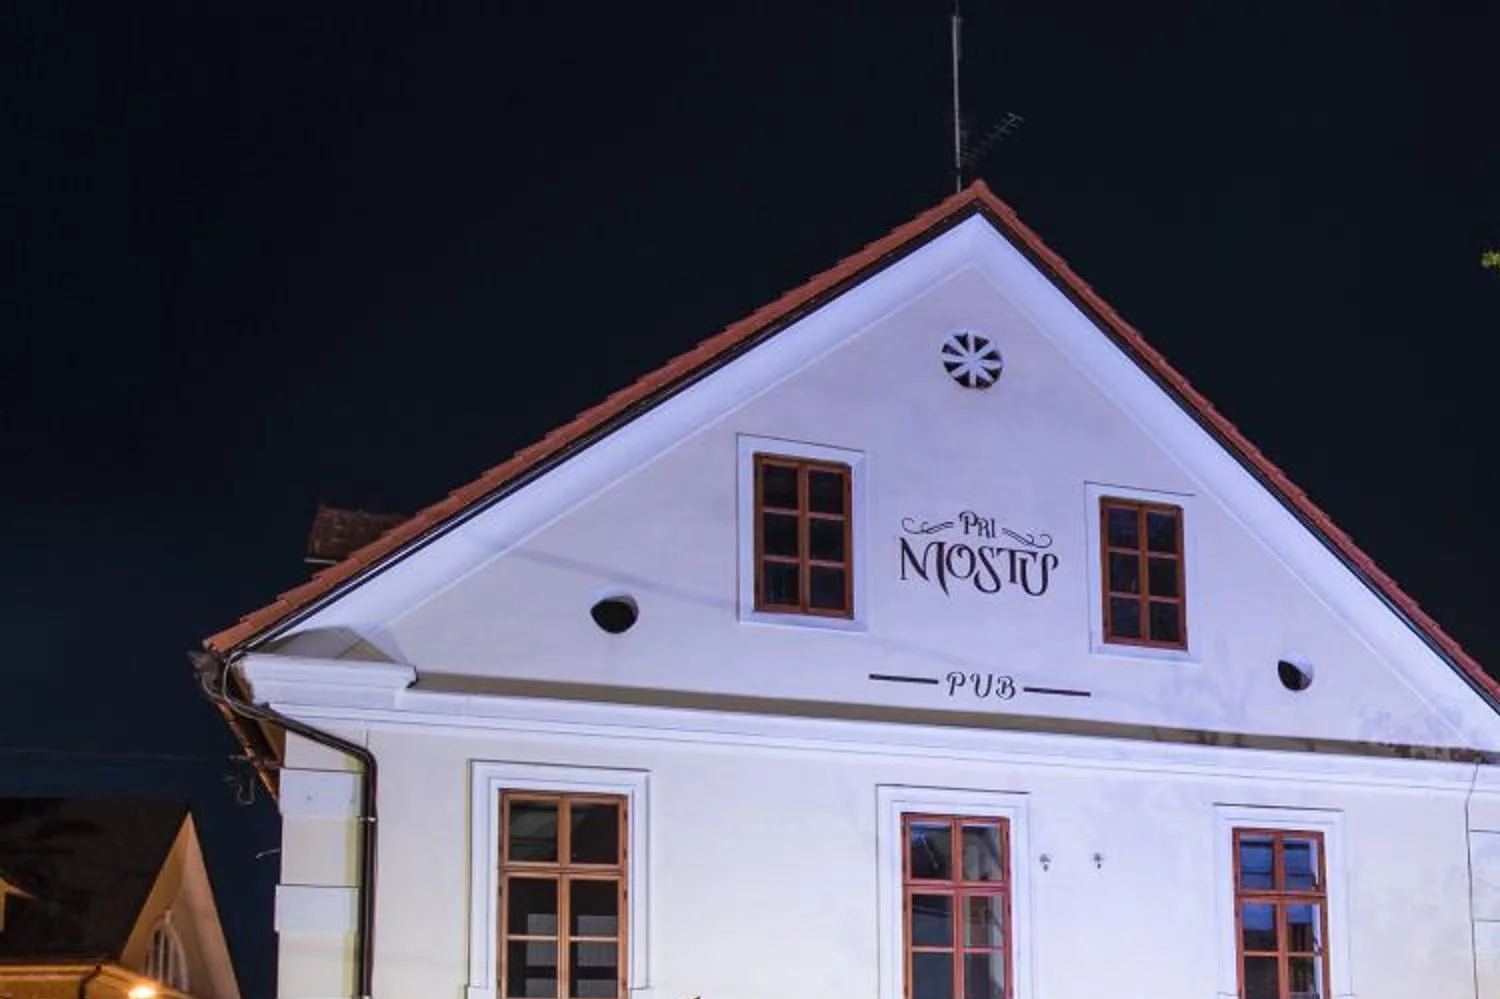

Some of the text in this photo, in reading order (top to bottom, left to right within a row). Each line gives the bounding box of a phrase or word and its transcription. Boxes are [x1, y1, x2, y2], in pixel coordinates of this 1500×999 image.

[959, 510, 995, 538] PRI
[899, 537, 1058, 597] MOSTU
[947, 671, 1016, 698] PUB
